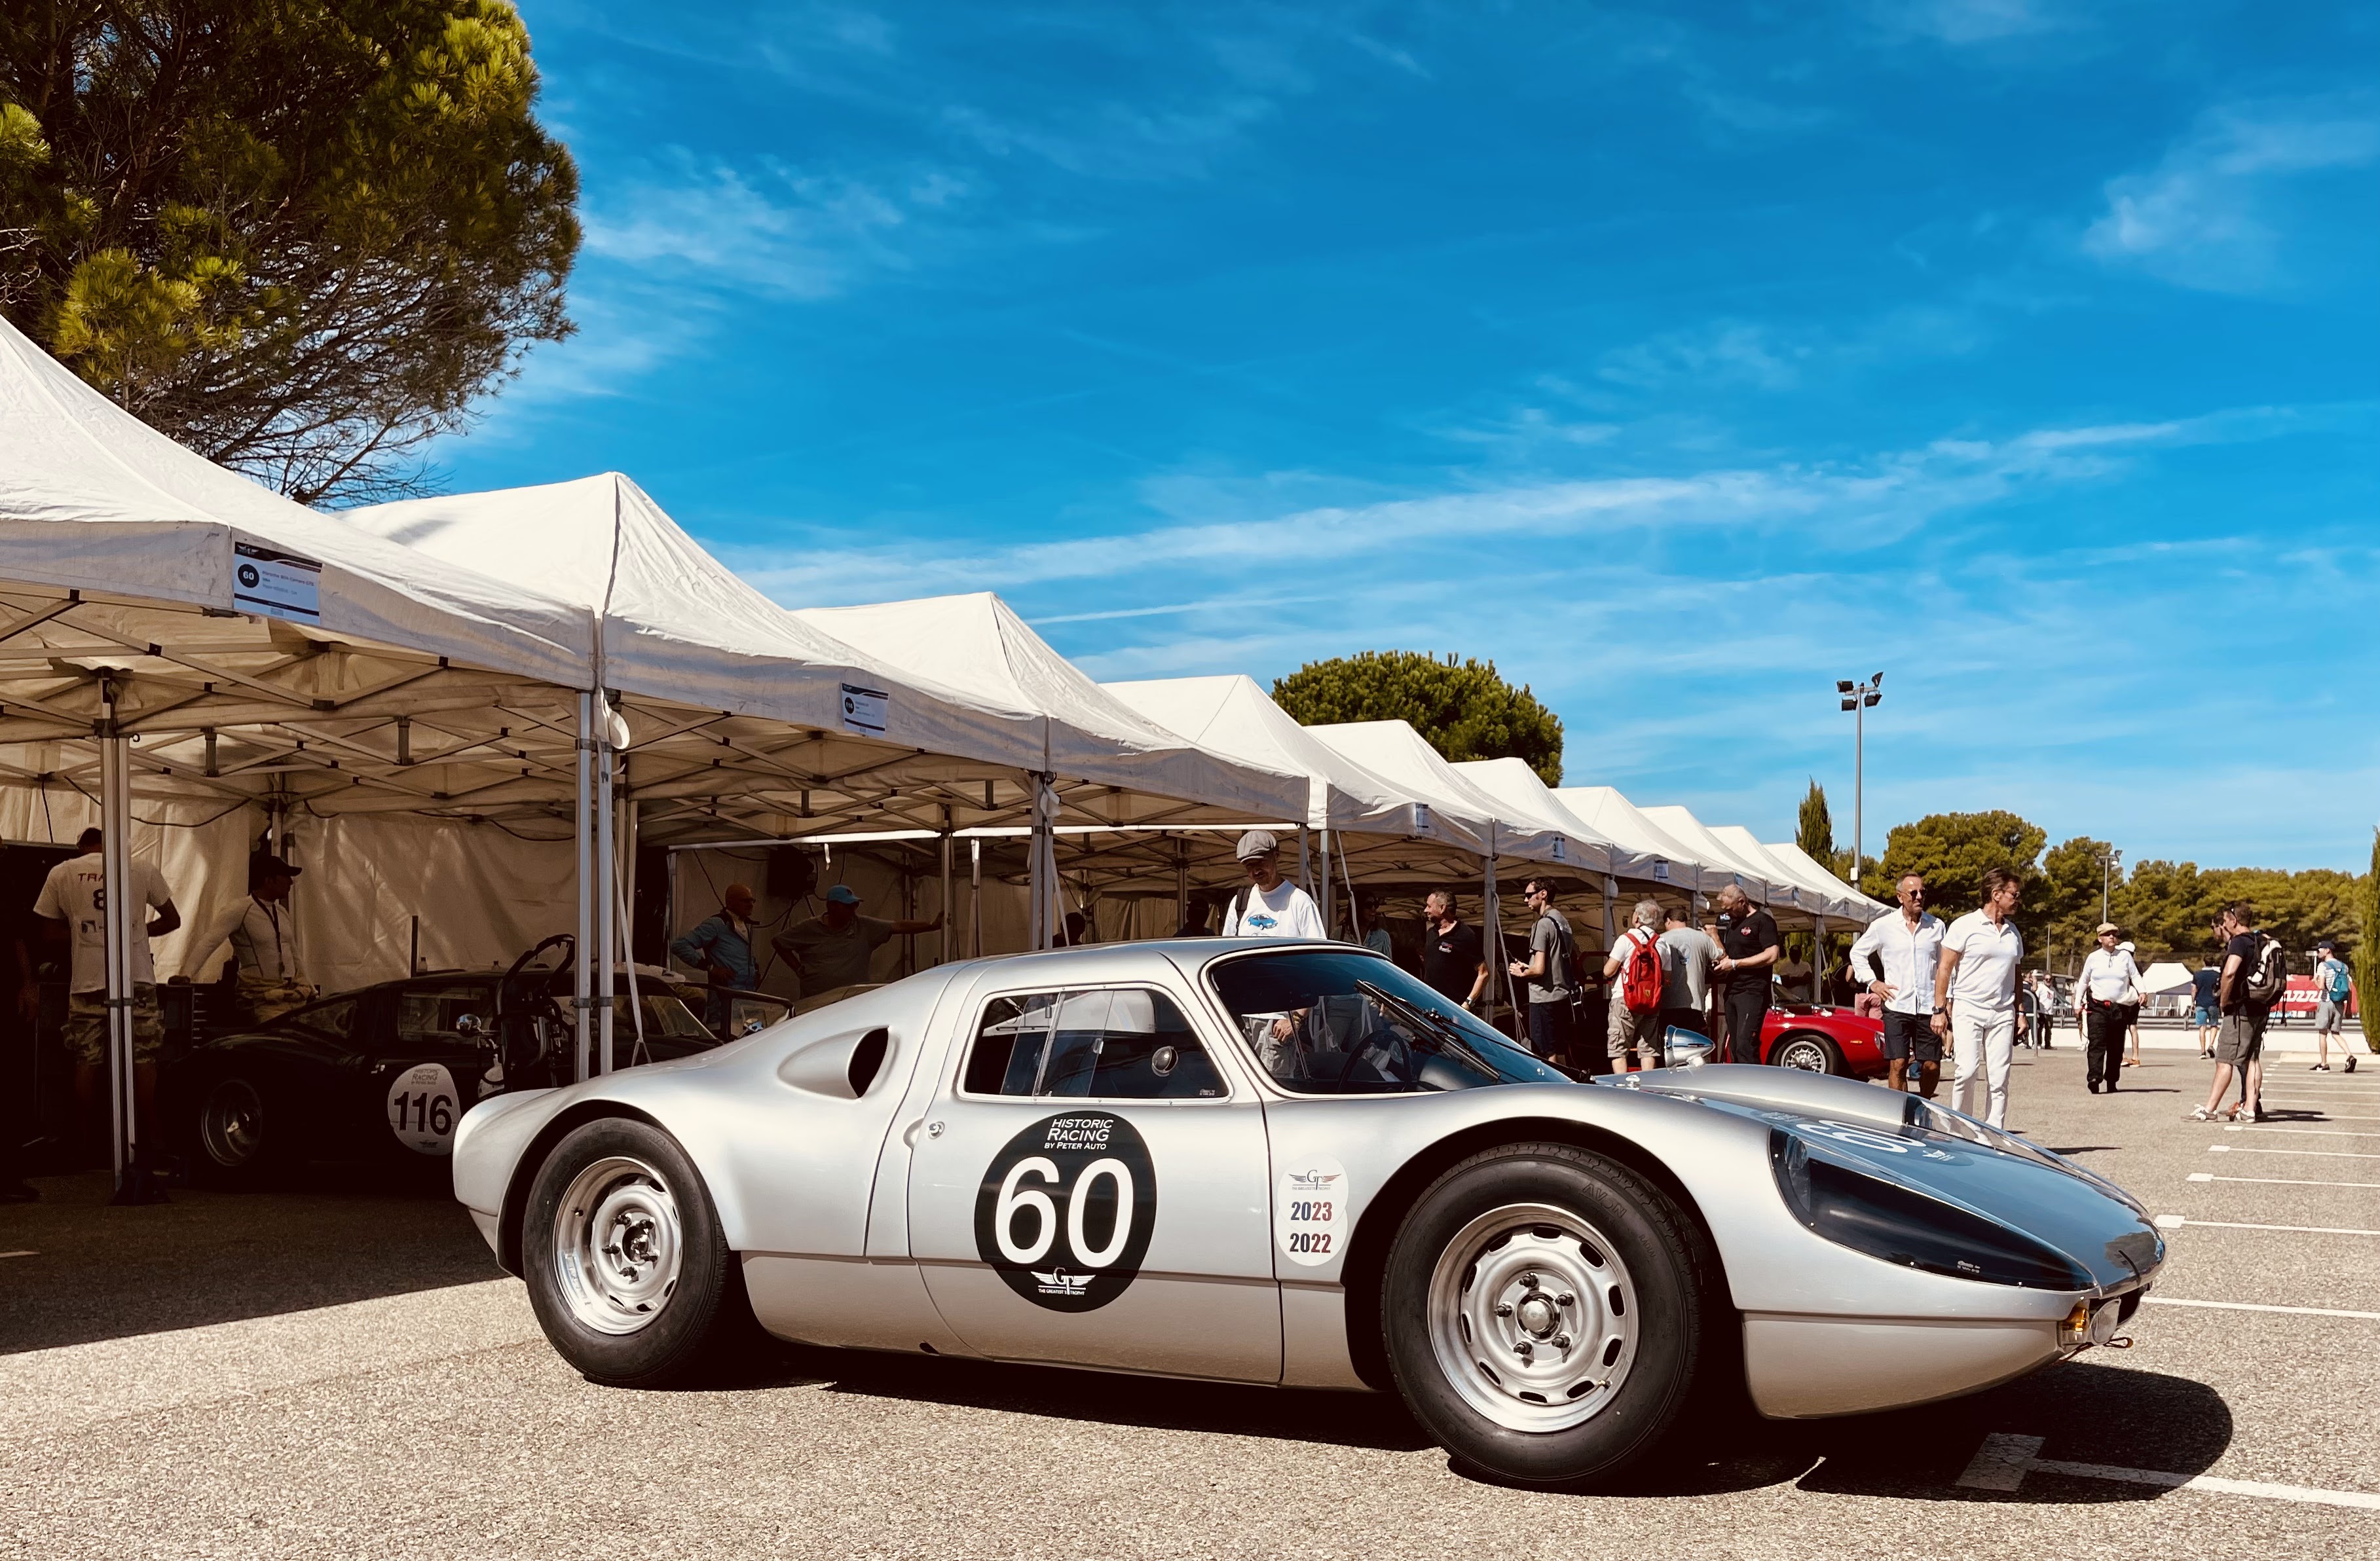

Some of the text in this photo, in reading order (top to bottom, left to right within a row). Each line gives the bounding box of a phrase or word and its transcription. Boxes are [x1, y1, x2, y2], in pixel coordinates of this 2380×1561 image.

[242, 570, 255, 581] 60
[411, 1073, 438, 1081] RACING
[394, 1091, 453, 1136] 116
[1051, 1118, 1114, 1129] HISTORIC
[1047, 1128, 1110, 1141] RACING
[1056, 1141, 1083, 1150] PETER
[1582, 1183, 1627, 1219] AVON
[994, 1156, 1134, 1268] 60
[1290, 1201, 1332, 1221] 2023
[1289, 1232, 1331, 1253] 2022
